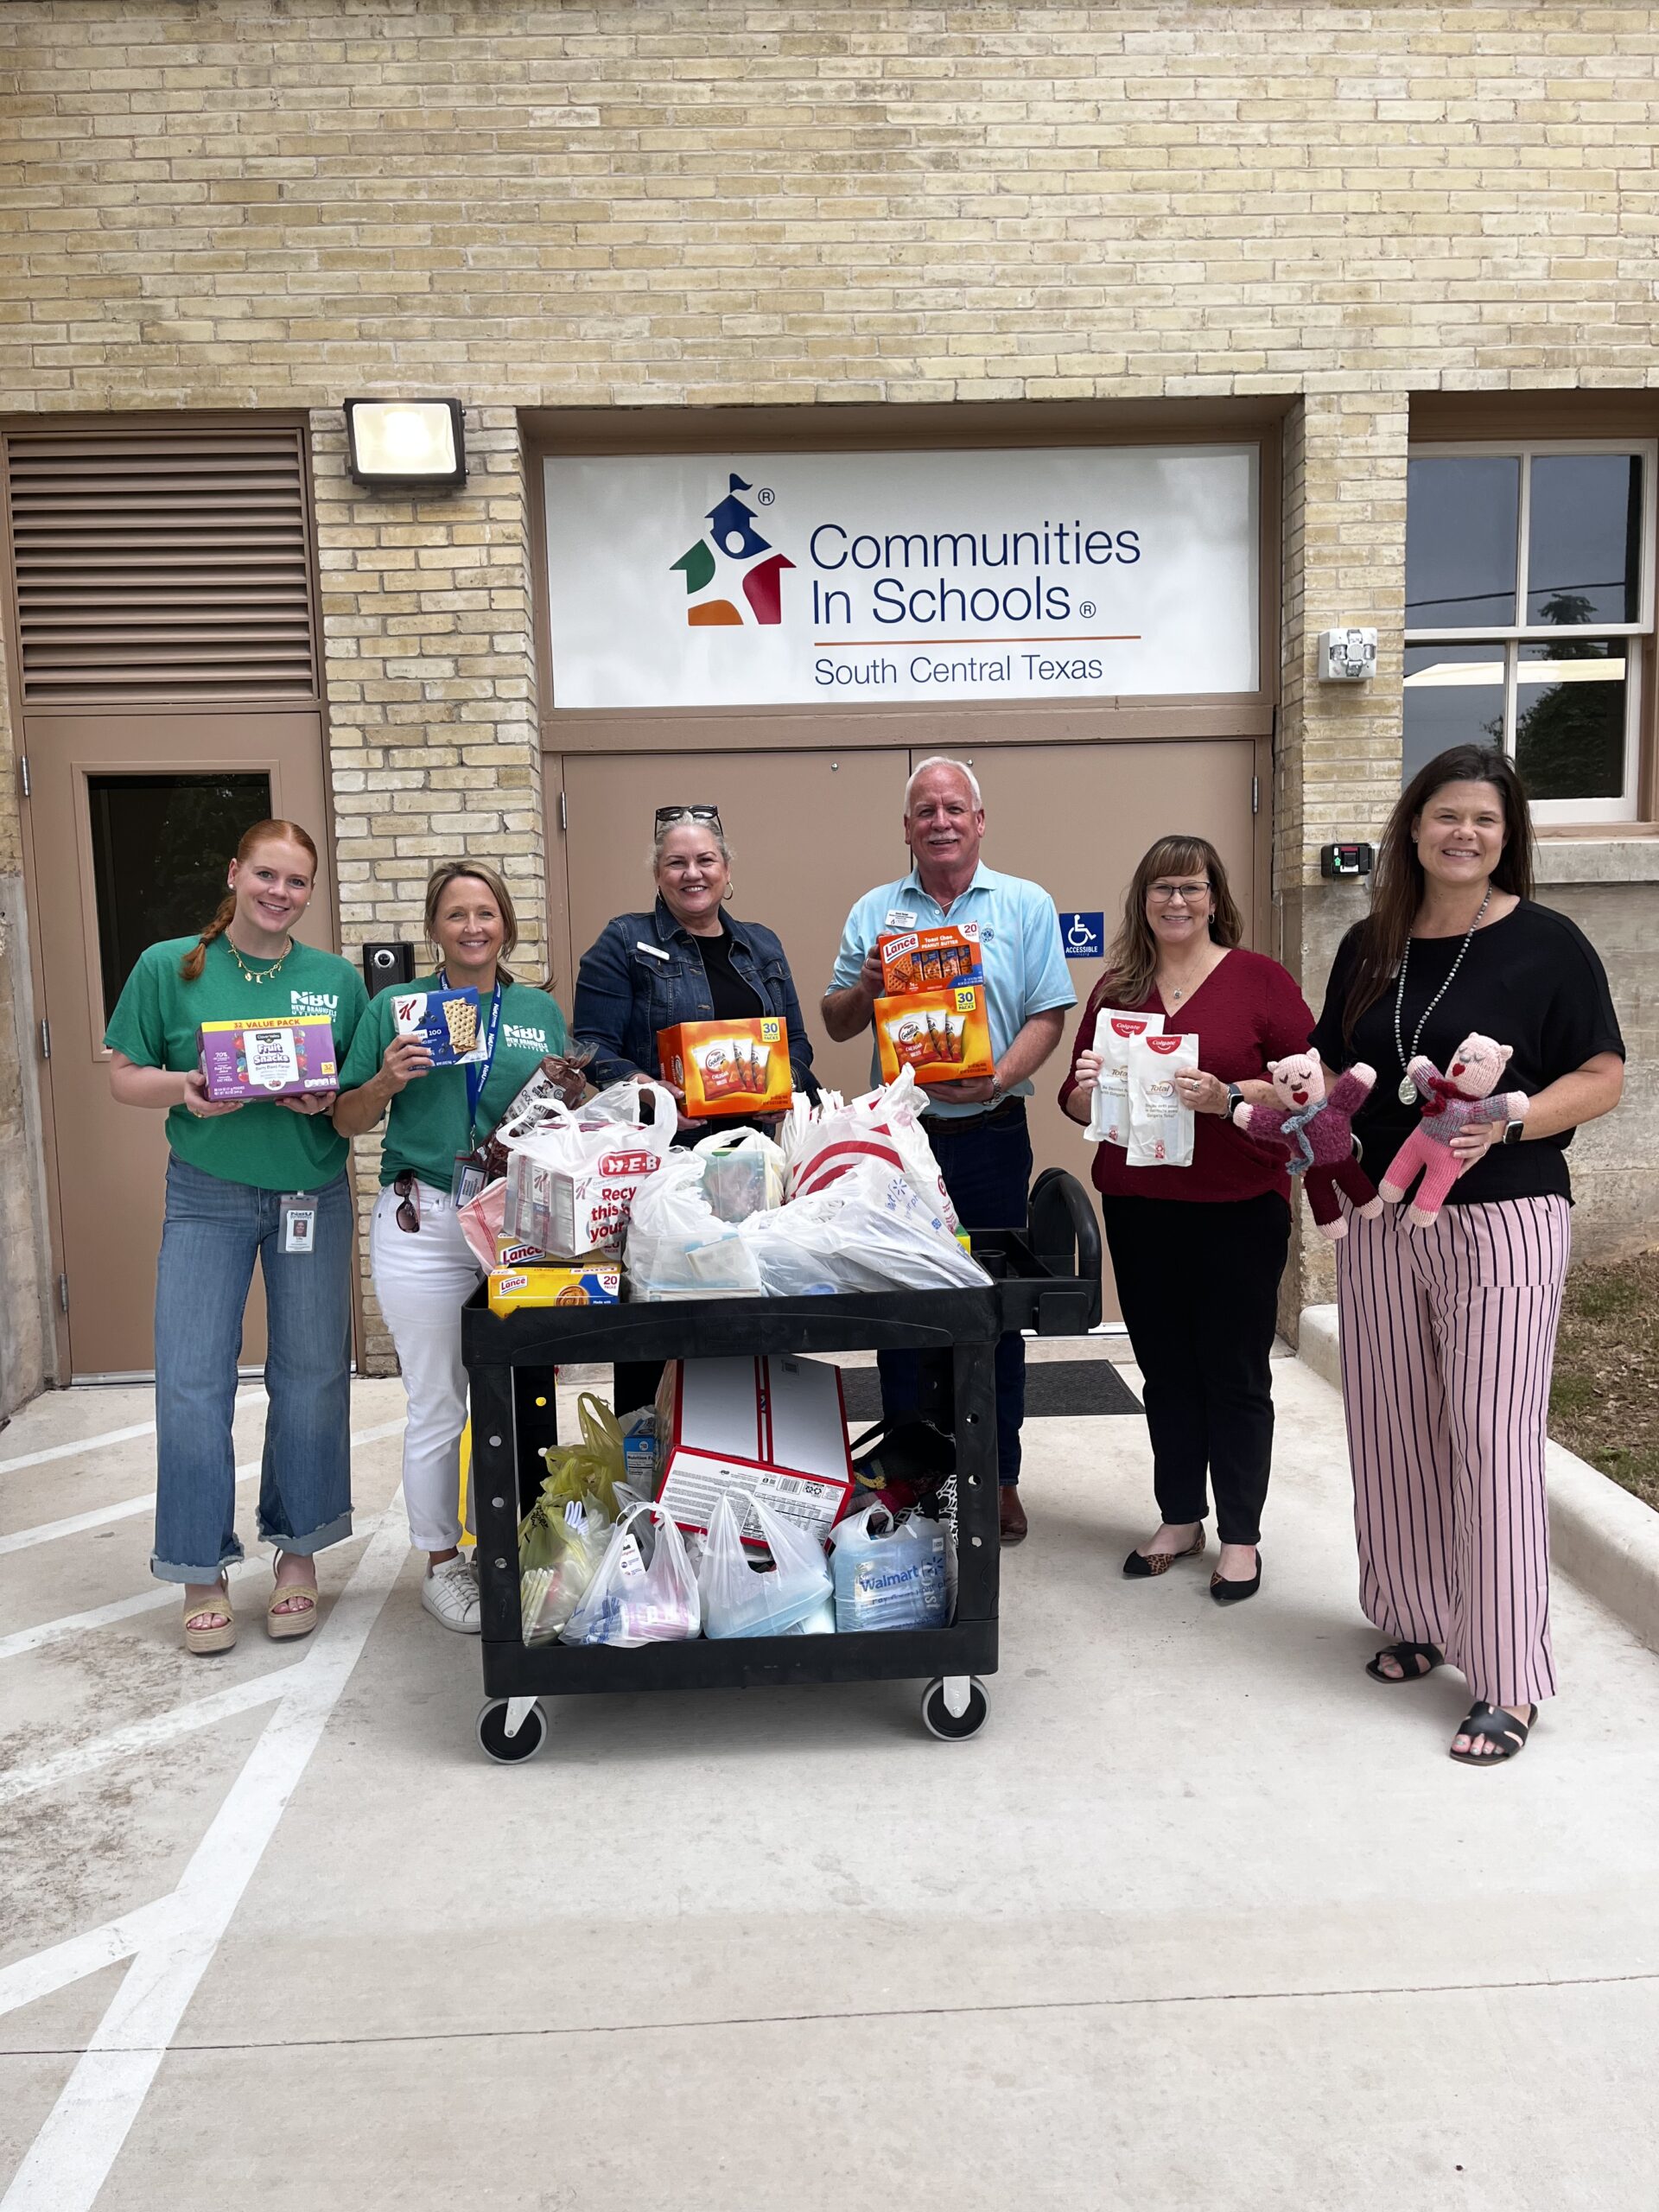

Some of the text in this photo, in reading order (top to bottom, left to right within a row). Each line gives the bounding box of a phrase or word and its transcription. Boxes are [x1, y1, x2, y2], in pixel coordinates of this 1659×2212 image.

[810, 520, 1141, 569] Communities
[812, 575, 1071, 625] In Schools
[814, 654, 1103, 685] South Central Texas
[963, 924, 977, 934] 20
[885, 937, 917, 957] Lance
[290, 990, 339, 1009] NBU
[957, 992, 974, 1003] 30
[398, 1000, 416, 1020] K
[503, 1024, 545, 1042] NBU
[763, 1023, 778, 1033] 30
[257, 1044, 283, 1054] Fruit
[253, 1054, 290, 1065] Snacks
[532, 1087, 547, 1098] QUAK
[601, 1187, 637, 1202] Recy
[592, 1204, 619, 1221] this
[590, 1222, 624, 1243] your
[503, 1246, 543, 1265] Lance
[501, 1278, 525, 1291] Lance
[603, 1275, 618, 1285] 20
[861, 1566, 918, 1592] Walmart
